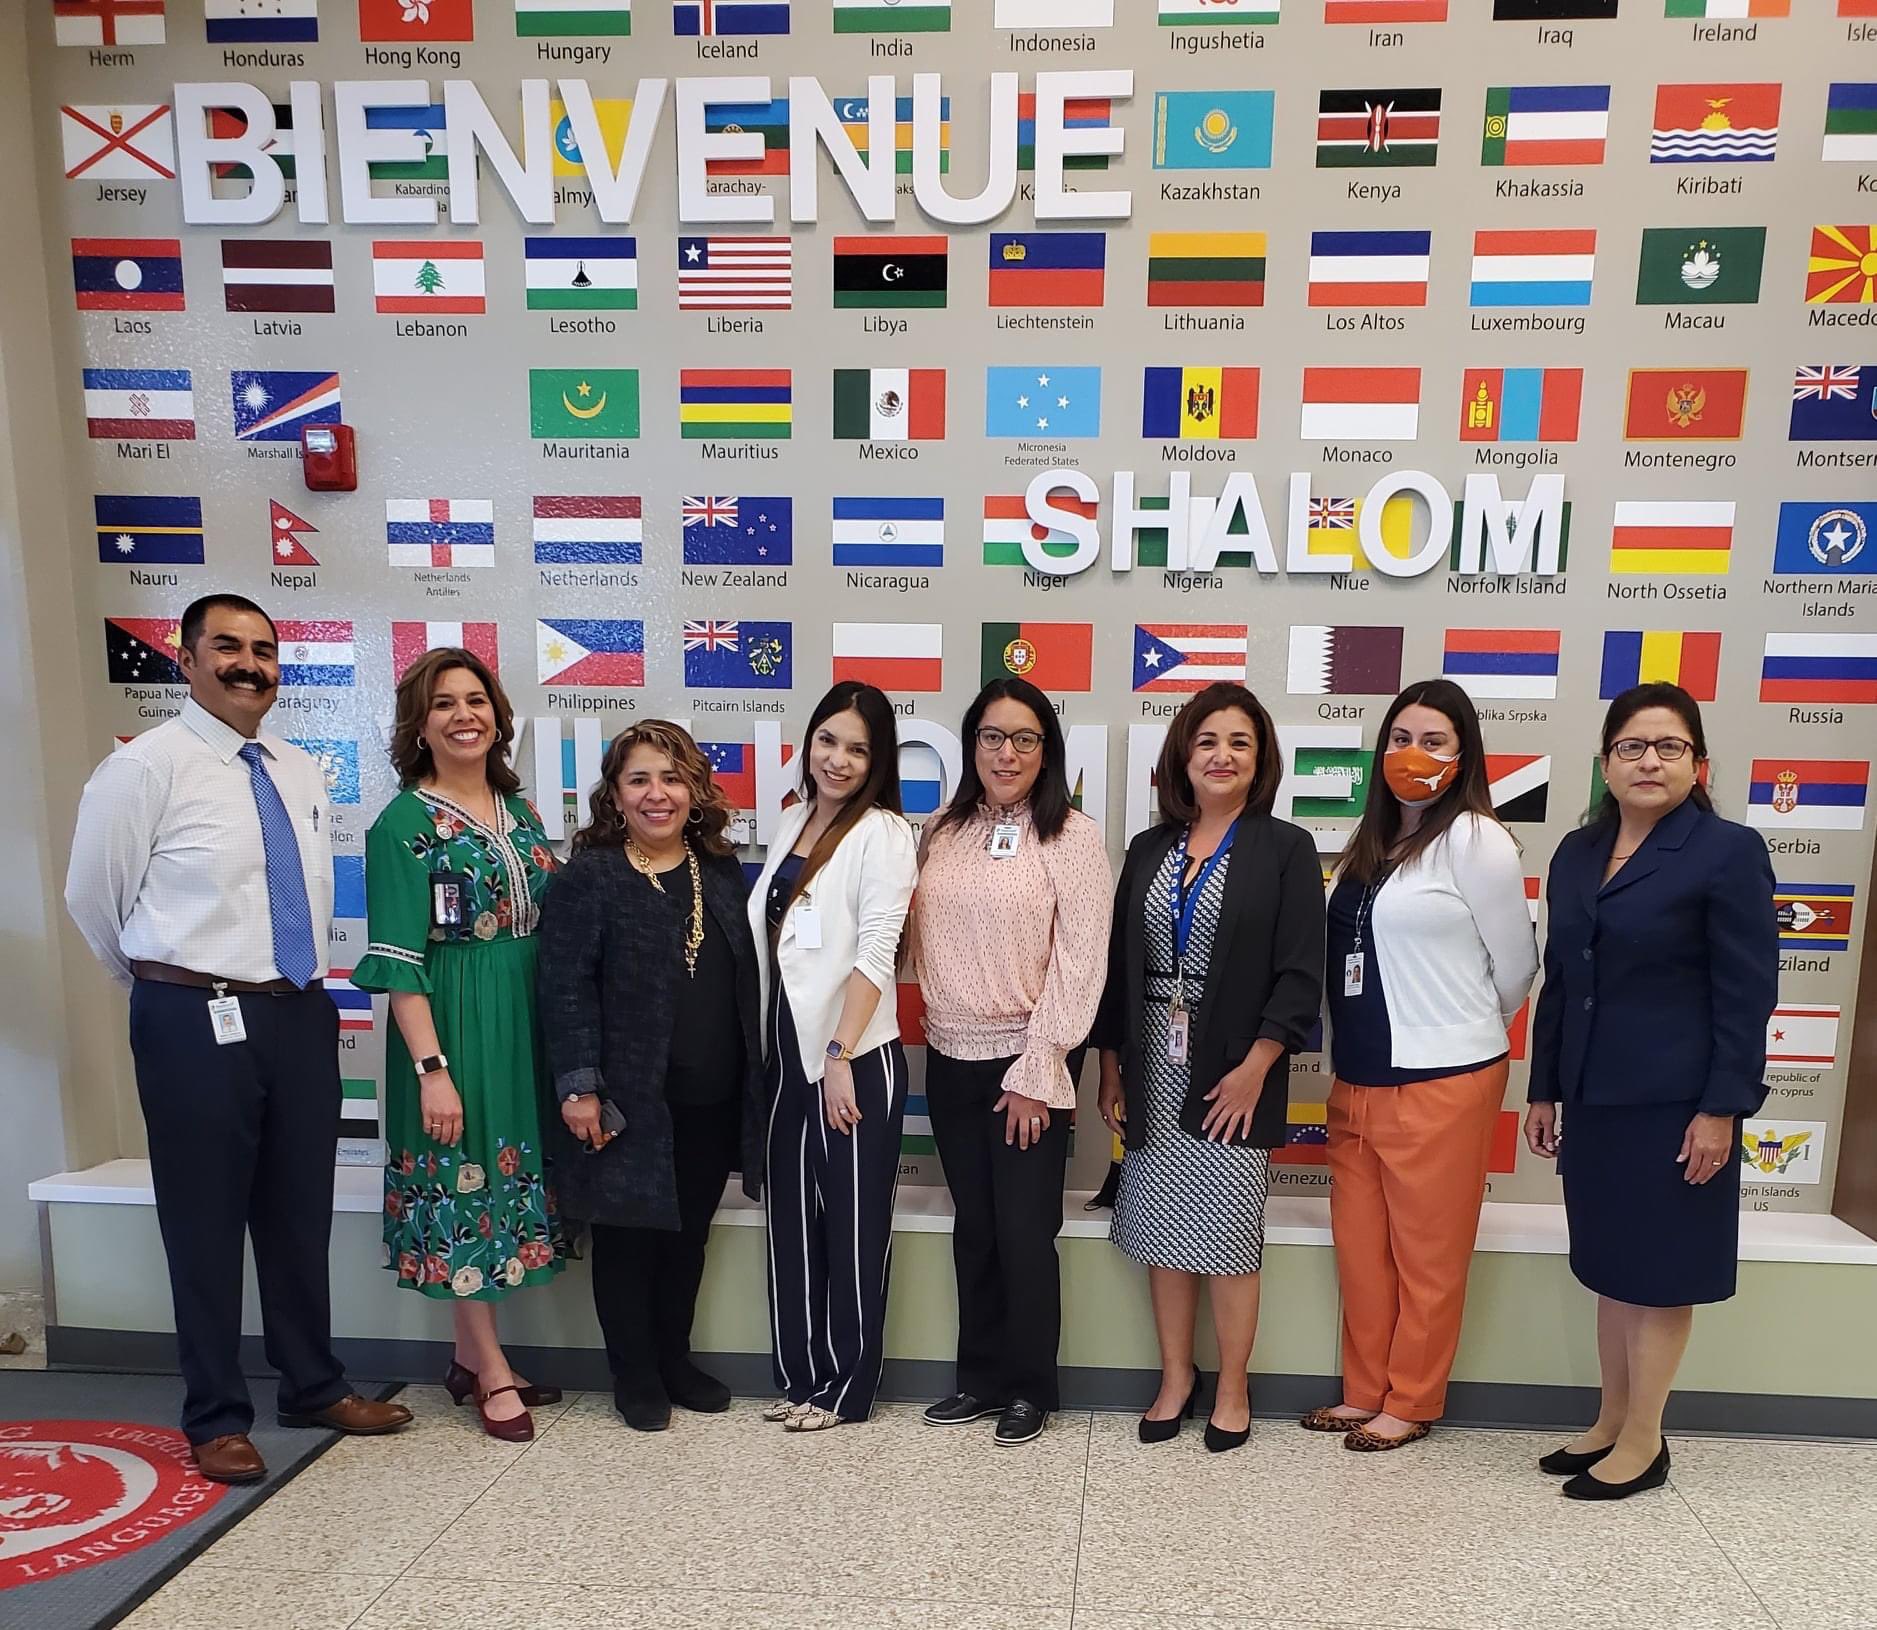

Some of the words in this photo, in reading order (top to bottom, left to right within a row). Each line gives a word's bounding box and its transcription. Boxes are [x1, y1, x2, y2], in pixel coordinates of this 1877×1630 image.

[1369, 29, 1403, 47] Iran
[1538, 26, 1574, 49] Iraq
[1693, 23, 1758, 42] Ireland
[697, 39, 758, 59] Iceland
[871, 37, 913, 57] India
[1010, 33, 1096, 52] Indonesia
[1170, 30, 1264, 55] Ingushetia
[89, 49, 135, 67] Herm
[223, 49, 305, 67] Honduras
[365, 47, 412, 69] Hong
[416, 47, 461, 69] Kong
[537, 42, 611, 64] Hungary
[174, 70, 1133, 224] BIENVENUE
[708, 179, 767, 197] arachay-
[1160, 181, 1260, 201] Kazakhstan
[1347, 181, 1401, 203] Kenya
[1495, 178, 1584, 198] Khakassia
[1676, 175, 1742, 195] Kiribati
[96, 184, 147, 206] Jersey
[114, 316, 153, 335] Laos
[253, 319, 302, 336] Latvia
[396, 319, 467, 337] Lebanon
[550, 316, 616, 334] Lesotho
[707, 315, 763, 333] Liberia
[863, 315, 908, 337] Libya
[996, 314, 1095, 331] Liechtenstein
[1164, 312, 1245, 330] Lithuania
[1326, 314, 1358, 331] Los
[1362, 313, 1406, 331] Altos
[1471, 312, 1585, 335] Luxembourg
[1664, 311, 1725, 329] Macau
[116, 442, 152, 460] Mari
[156, 443, 170, 460] El
[247, 447, 292, 459] Marshall
[543, 442, 630, 459] Mauritania
[701, 443, 779, 459] Mauritius
[859, 443, 919, 460] Mexico
[1017, 443, 1067, 452] Micronesia
[1161, 444, 1236, 462] Moldova
[1322, 446, 1393, 463] Monaco
[1004, 456, 1050, 466] Federated
[1052, 456, 1080, 466] States
[1475, 447, 1558, 469] Mongolia
[1624, 450, 1736, 472] Montenegro
[1021, 469, 1565, 577] SHALOM
[129, 569, 178, 586] Nauru
[271, 572, 316, 592] Nepal
[414, 572, 471, 583] Netherlands
[540, 569, 639, 587] Netherlands
[681, 570, 718, 587] New
[722, 570, 787, 587] Zealand
[847, 572, 929, 593] Nicaragua
[1023, 572, 1069, 592] Niger
[1163, 570, 1223, 593] Nigeria
[1329, 574, 1370, 593] Niue
[1447, 574, 1515, 594] Norfolk
[1515, 577, 1567, 595] Island
[1607, 582, 1658, 599] North
[1663, 583, 1727, 600] Ossetia
[1763, 579, 1834, 595] Northern
[1803, 602, 1856, 618] Islands
[124, 686, 162, 702] Papua
[548, 693, 636, 713] Philippines
[137, 705, 181, 719] Guinea
[278, 697, 338, 714] araguay
[693, 699, 739, 712] Pitcairn
[742, 698, 786, 714] Islands
[1317, 702, 1366, 720] Qatar
[1508, 709, 1547, 723] Srpska
[1789, 707, 1844, 724] Russia
[1767, 837, 1822, 856] Serbia
[1777, 955, 1831, 973] ziland
[1766, 1073, 1808, 1084] republic
[1809, 1073, 1822, 1083] of
[1780, 1088, 1814, 1098] cyprus
[1269, 1170, 1335, 1186] Venezue
[1761, 1186, 1800, 1198] Islands
[1753, 1201, 1769, 1211] US
[17, 1482, 214, 1577] LANGUAGE
